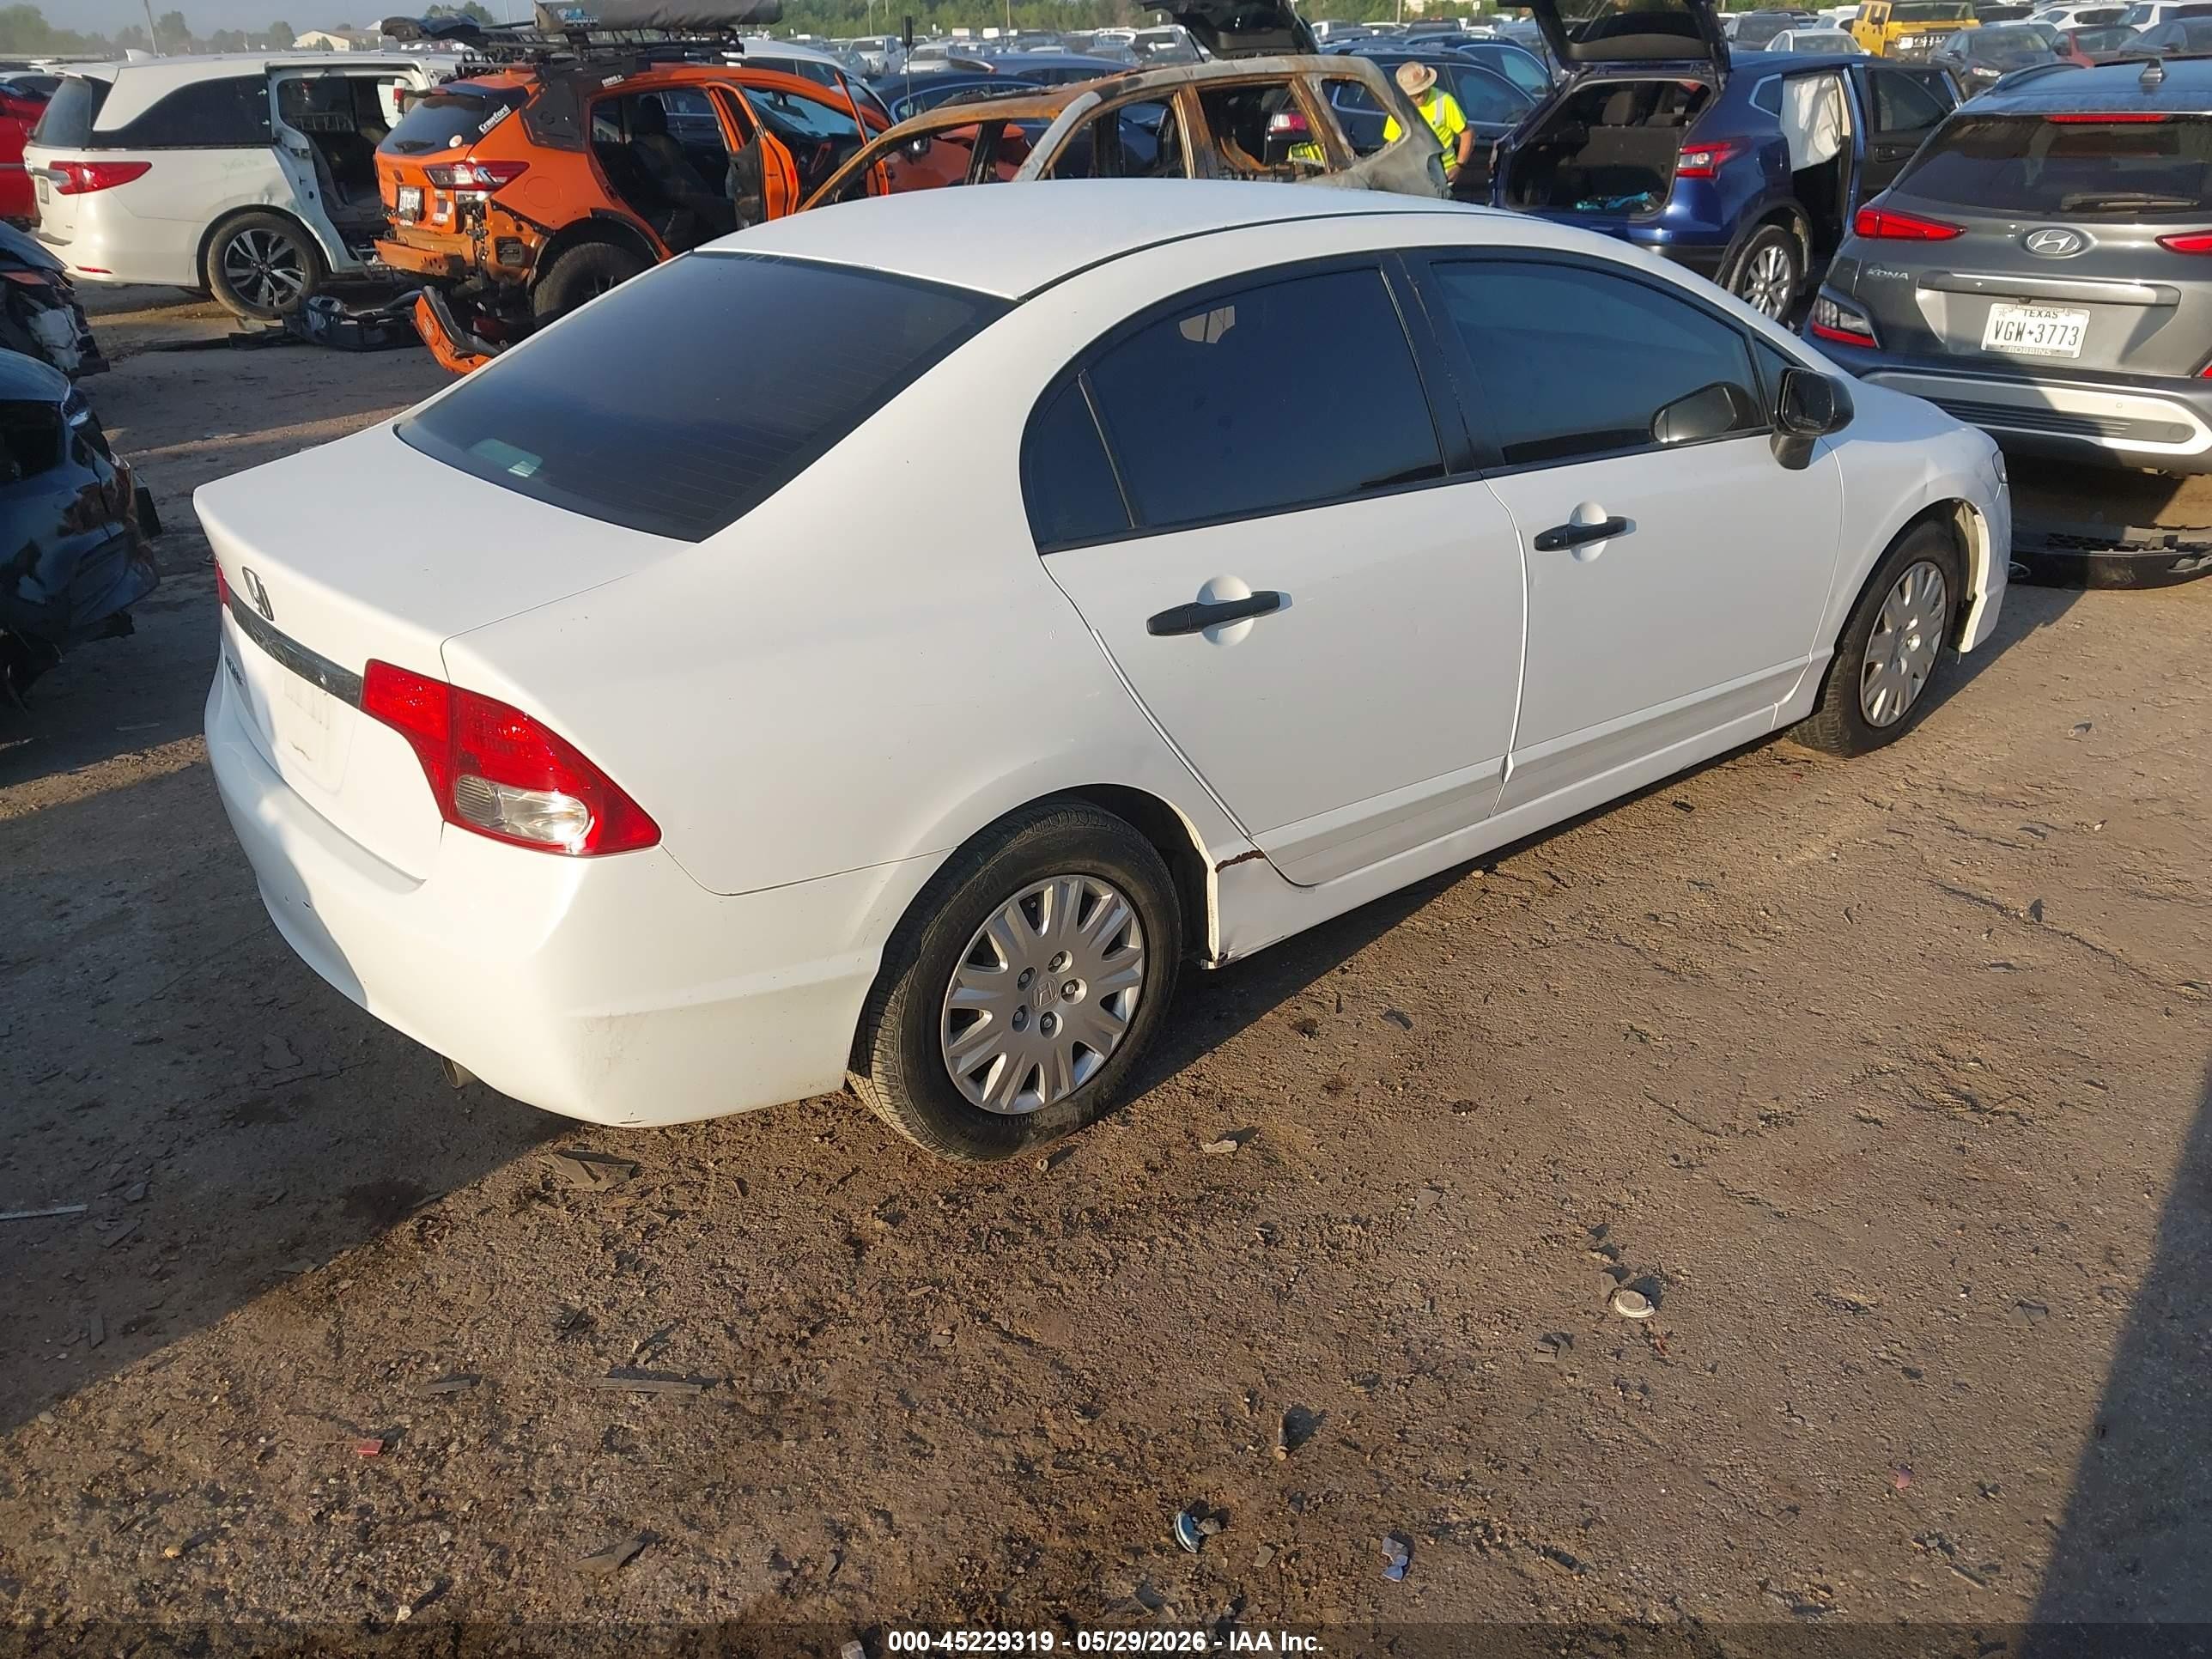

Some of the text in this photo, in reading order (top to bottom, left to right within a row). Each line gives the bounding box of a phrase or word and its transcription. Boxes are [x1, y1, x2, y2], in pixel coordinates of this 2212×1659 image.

[1868, 267, 1909, 281] KONA
[2023, 308, 2058, 319] TEXAS
[1994, 319, 2080, 346] VGW 3773
